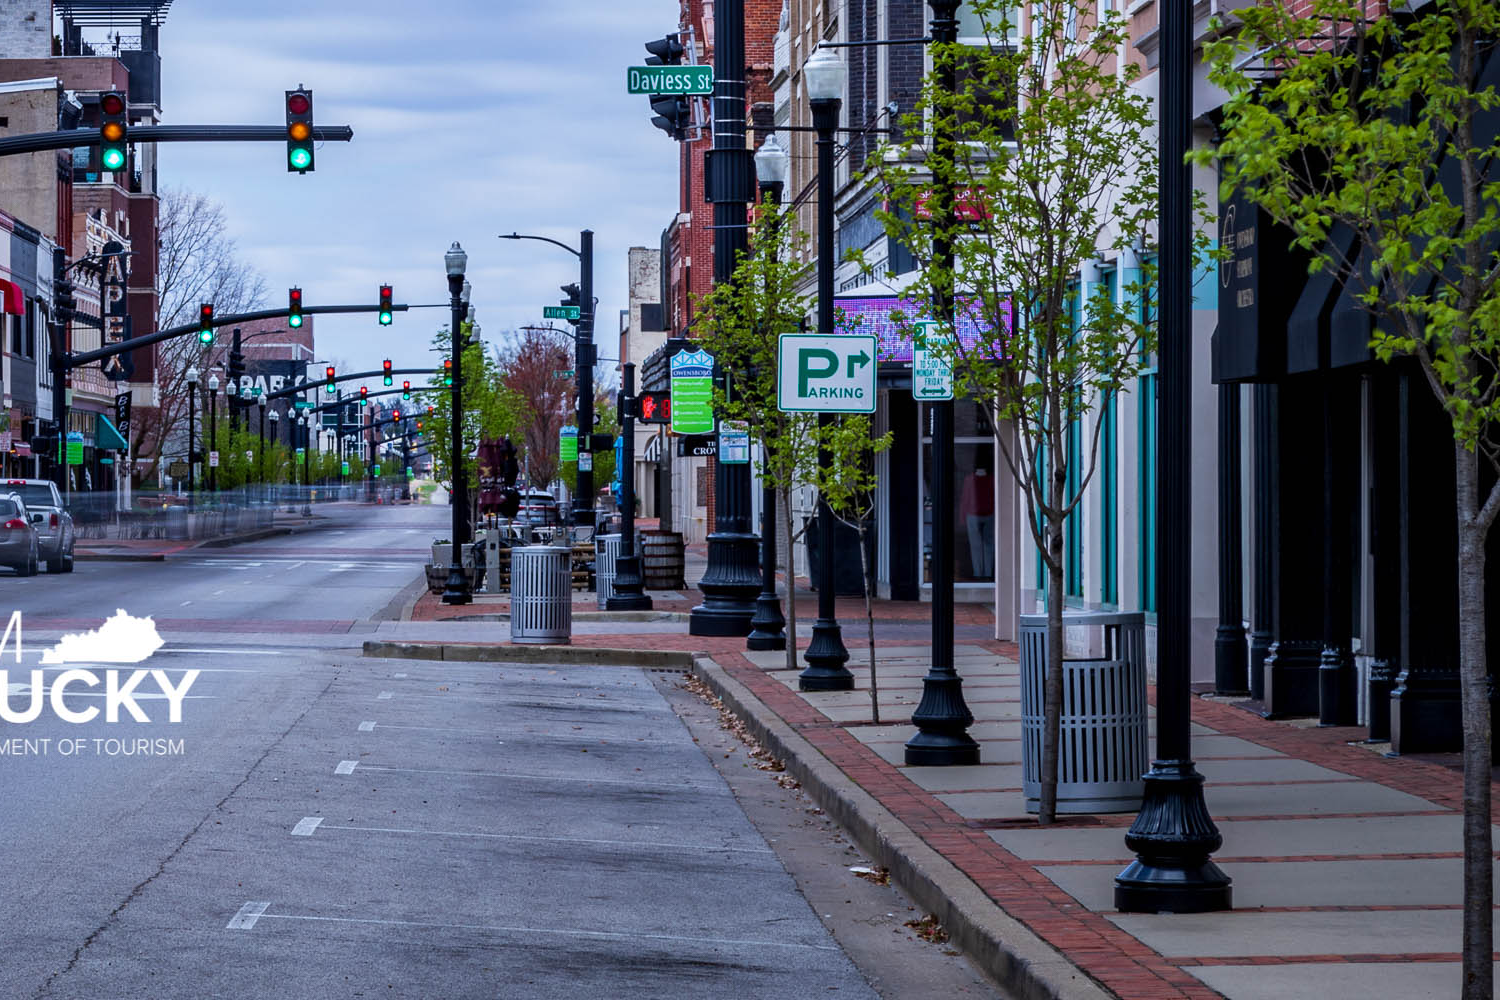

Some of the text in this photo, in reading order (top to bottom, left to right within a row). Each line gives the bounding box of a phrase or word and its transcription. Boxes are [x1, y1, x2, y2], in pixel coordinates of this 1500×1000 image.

[630, 70, 710, 90] Daviess St
[546, 307, 577, 317] Allen St
[928, 360, 938, 368] 5:00
[672, 369, 712, 377] OWENSBORO
[798, 348, 864, 398] PARKING
[916, 369, 935, 377] MONDAY
[924, 378, 943, 386] FRIDAY
